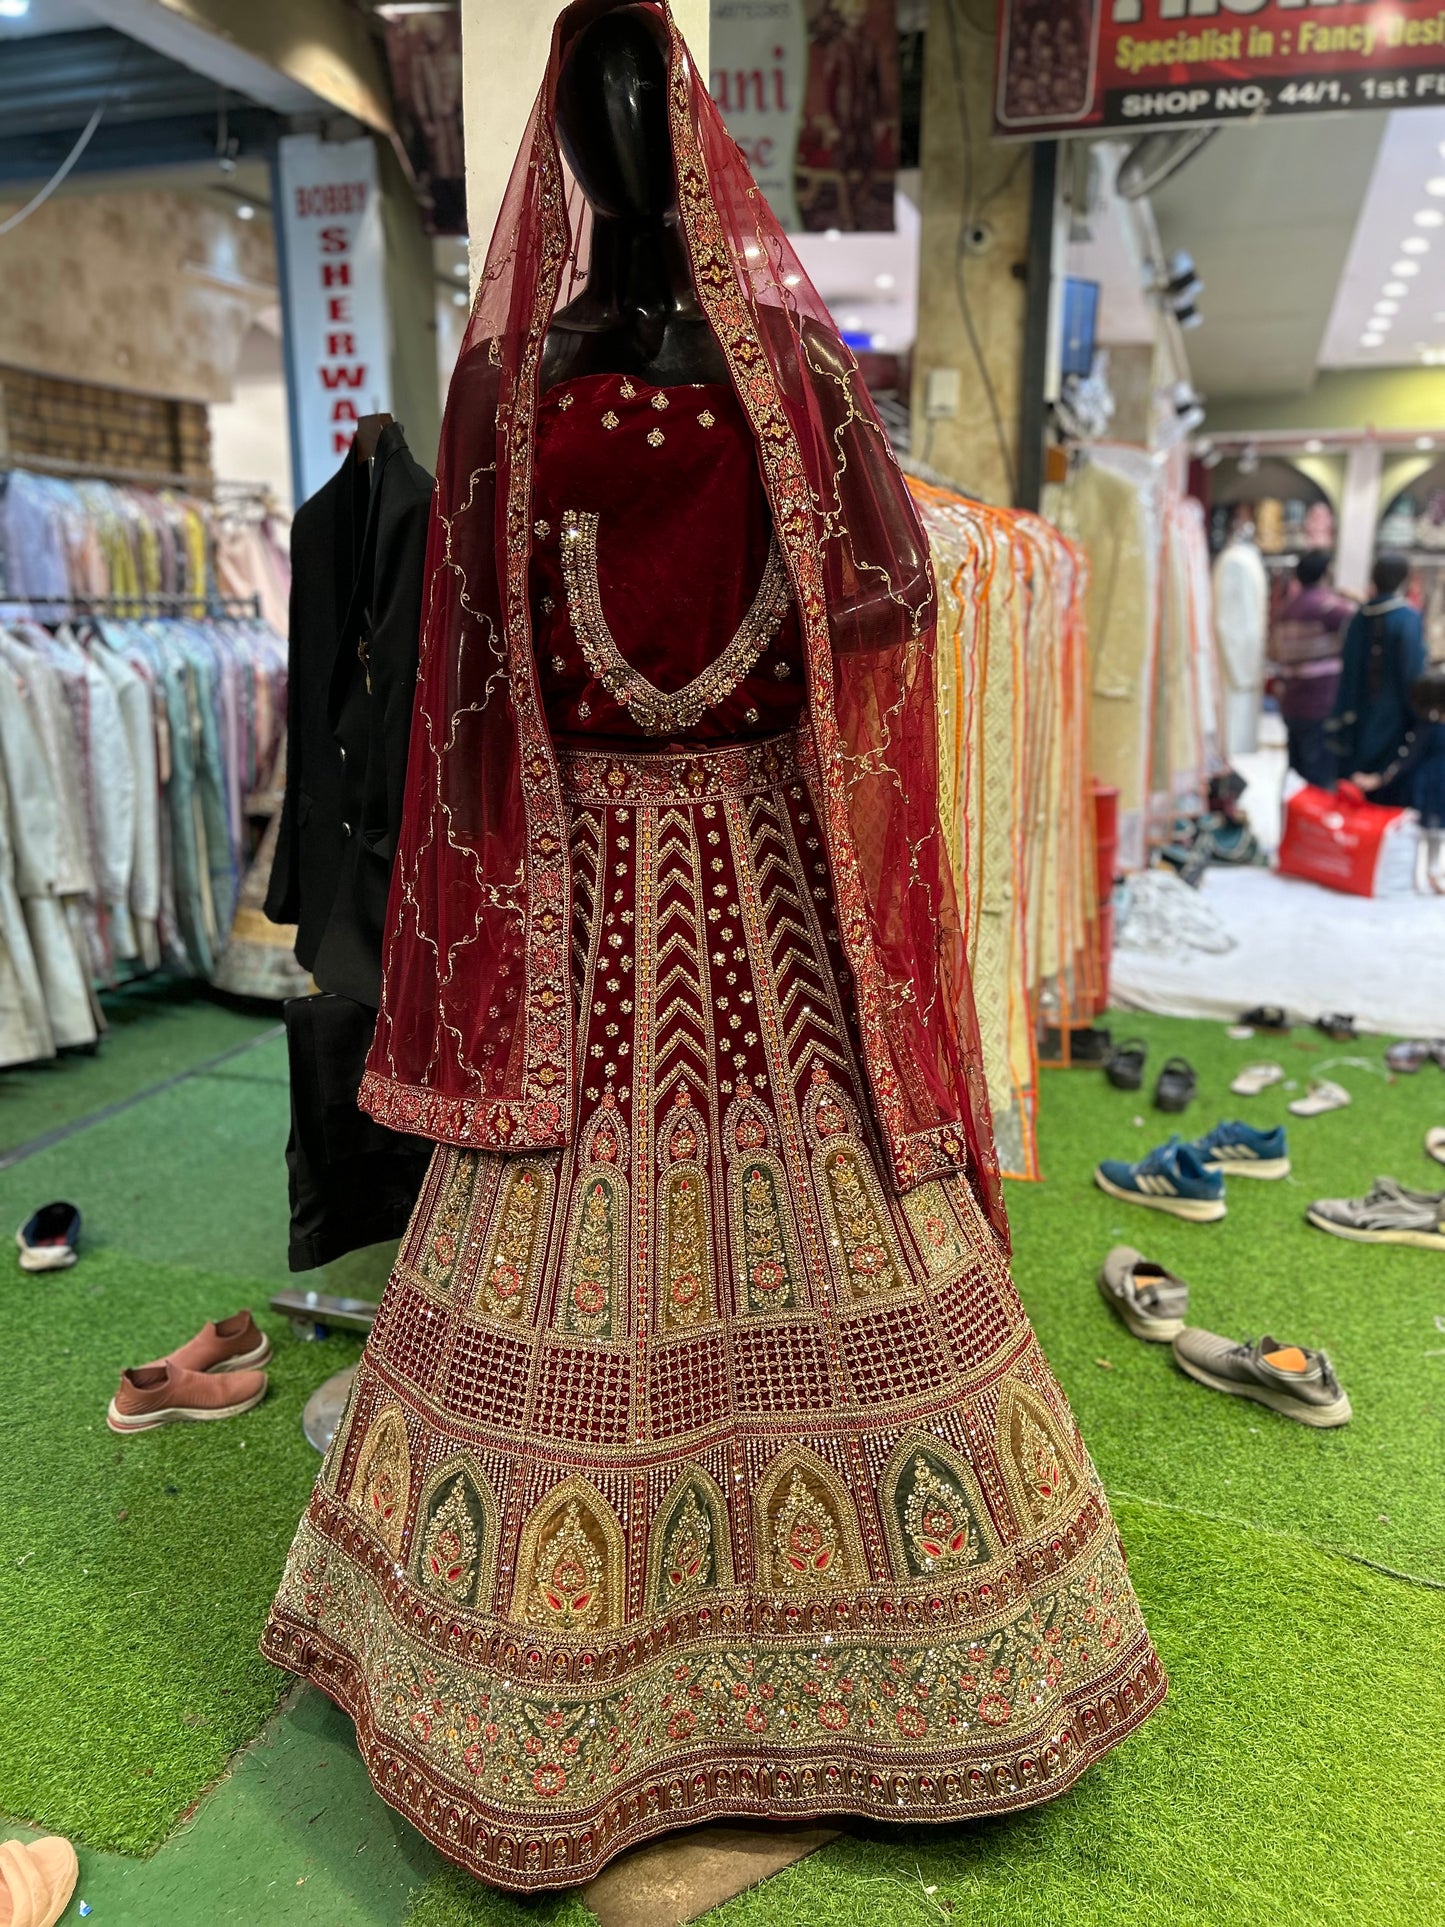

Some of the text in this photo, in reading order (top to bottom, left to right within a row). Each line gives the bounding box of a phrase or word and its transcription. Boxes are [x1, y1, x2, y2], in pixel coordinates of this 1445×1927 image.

[1115, 28, 1242, 74] Specialist
[1248, 26, 1274, 57] in
[1298, 21, 1377, 56] Fancy
[1121, 90, 1210, 117] SHOP
[1360, 78, 1409, 99] 1st
[296, 183, 367, 218] BOBBY
